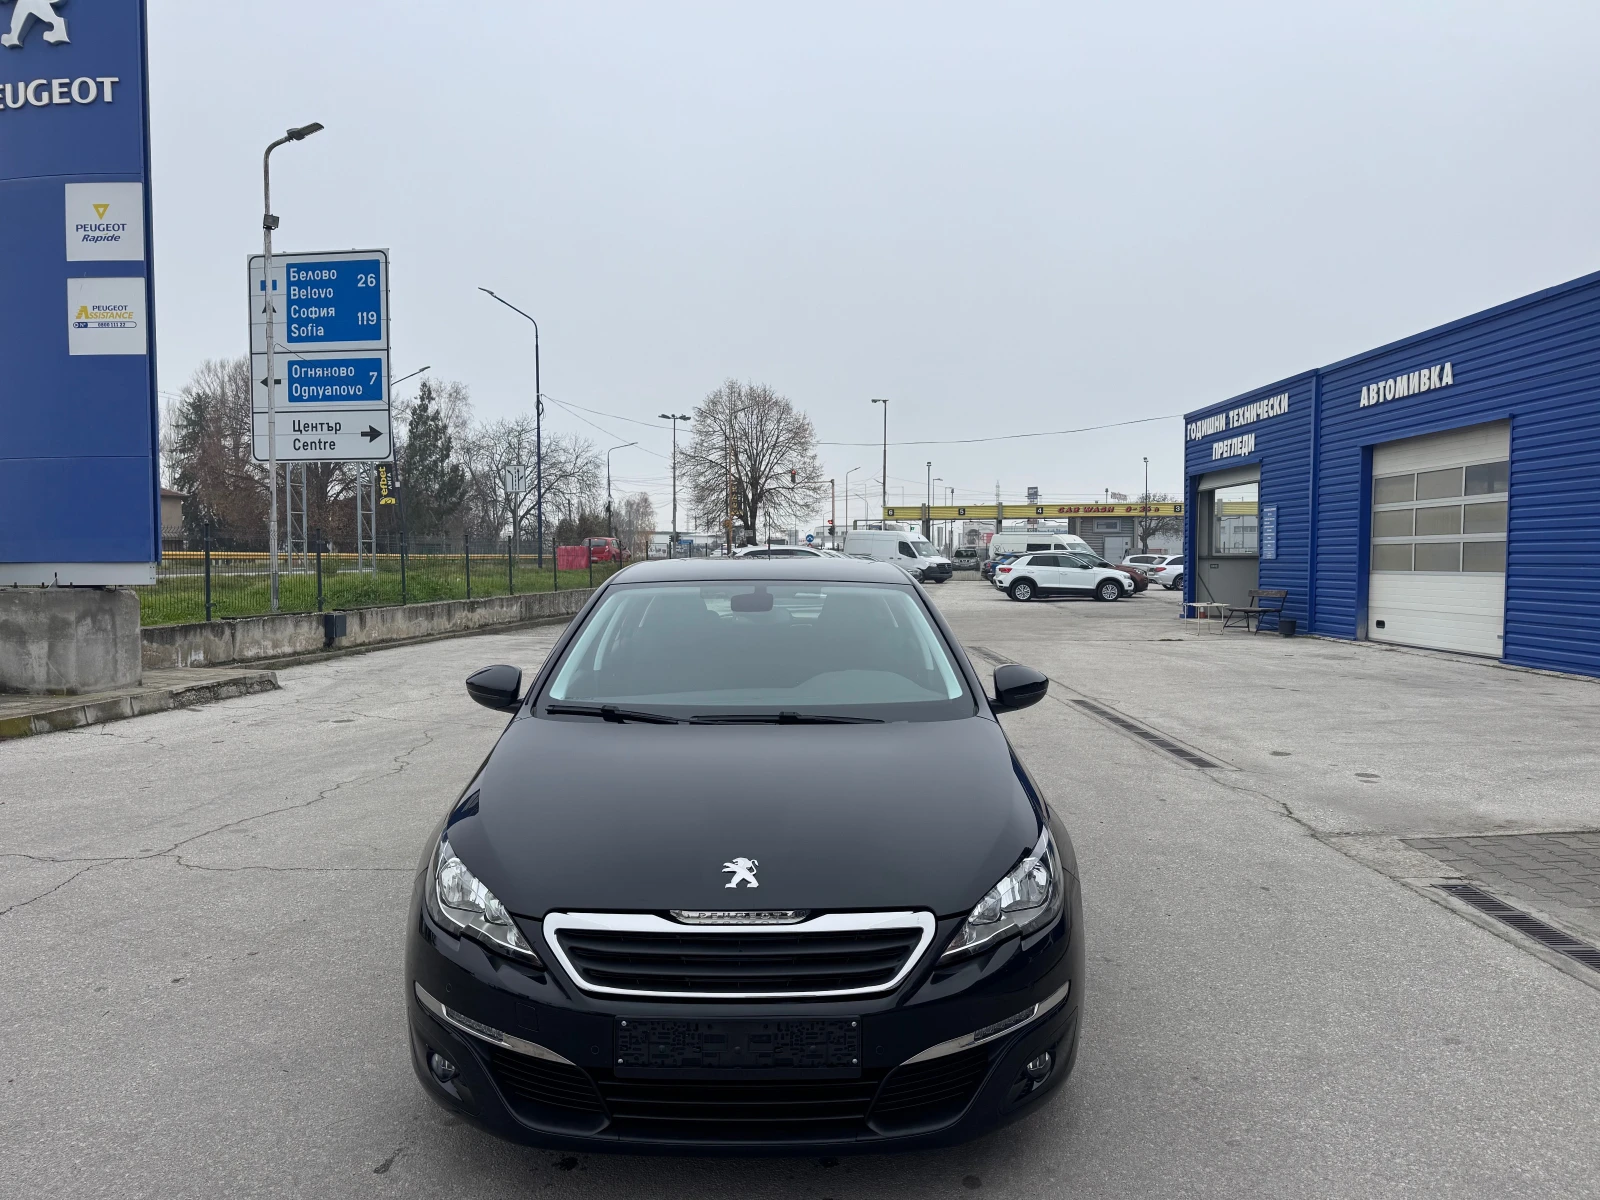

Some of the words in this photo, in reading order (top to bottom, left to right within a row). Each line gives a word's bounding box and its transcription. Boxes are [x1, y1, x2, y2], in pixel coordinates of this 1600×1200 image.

[0, 77, 119, 109] UGEOT
[75, 223, 127, 232] PEUGEOT
[81, 233, 121, 243] Rapide
[290, 268, 337, 281] Белово
[357, 274, 376, 287] 26
[290, 286, 334, 299] Belovo
[291, 305, 336, 319] София
[357, 311, 377, 325] 119
[291, 323, 325, 337] Sofia
[292, 365, 355, 378] Огняново
[369, 372, 378, 385] 7
[292, 383, 363, 399] Ognyanovo
[1360, 362, 1454, 407] АВТОМИВКА
[1187, 413, 1226, 441] ГОДИШНИ
[1229, 392, 1289, 428] ТЕХНИЧЕСКИ
[293, 420, 342, 434] Център
[293, 438, 336, 451] Centre
[1212, 433, 1256, 460] ПРЕГЛЕДИ
[379, 466, 388, 496] efbet
[698, 912, 782, 920] PEUGEOT
